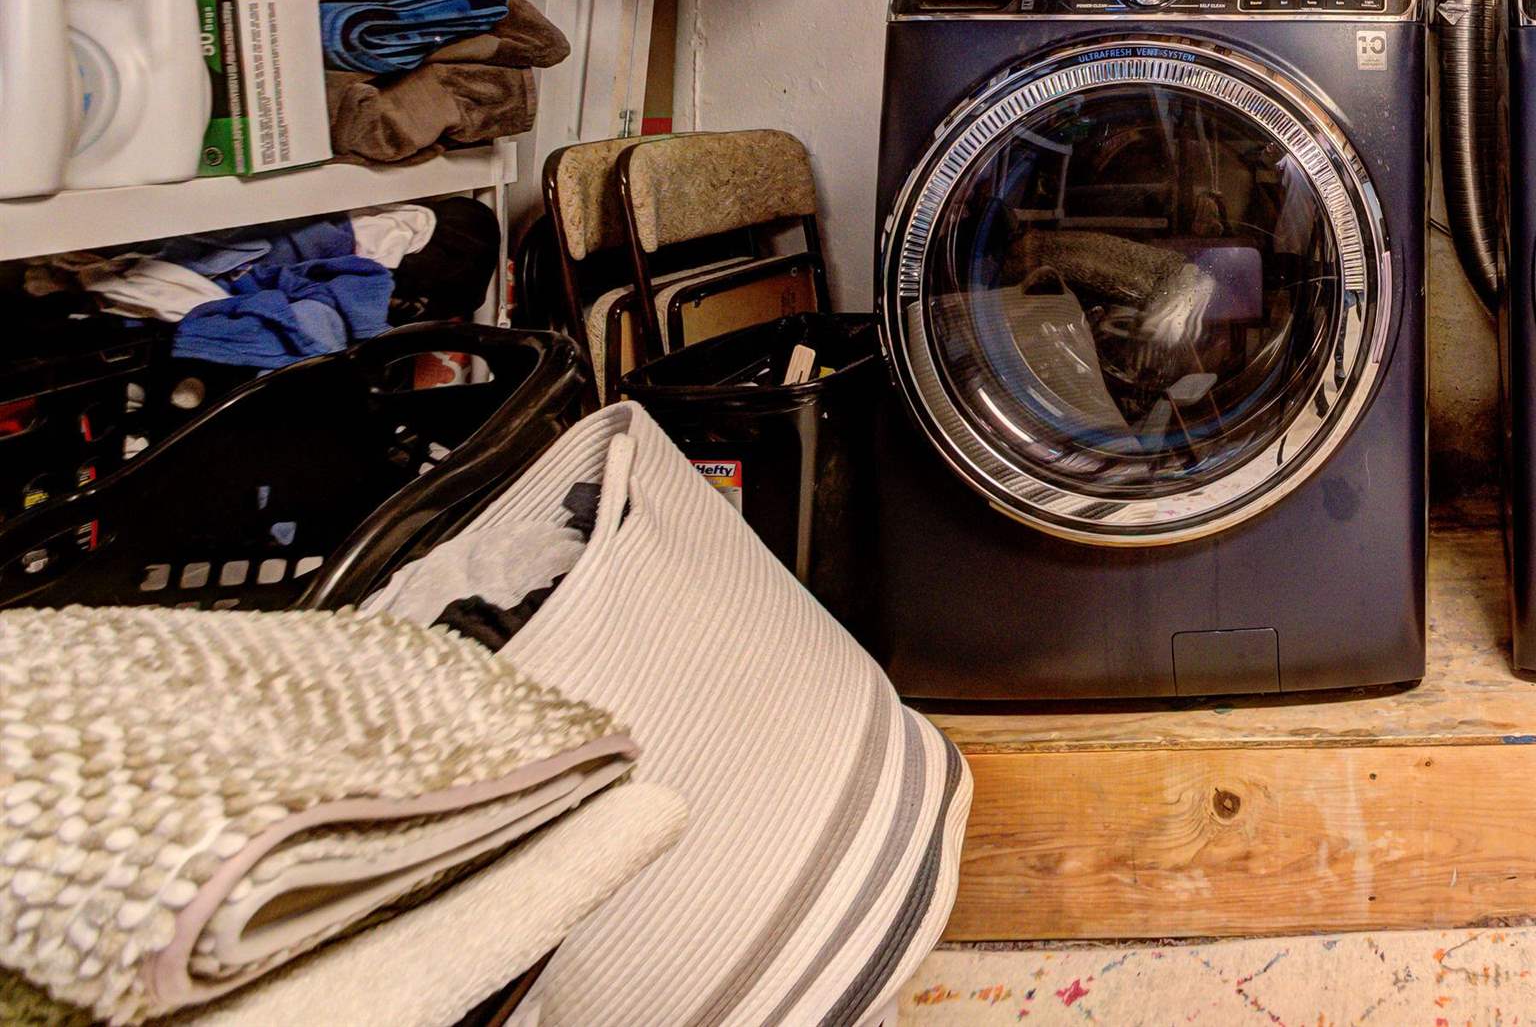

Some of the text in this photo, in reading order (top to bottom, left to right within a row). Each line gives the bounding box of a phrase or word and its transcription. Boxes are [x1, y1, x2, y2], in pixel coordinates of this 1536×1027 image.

[1078, 47, 1196, 63] ULTRAFRESH VENT SYSTEM
[695, 464, 733, 477] Hefty
